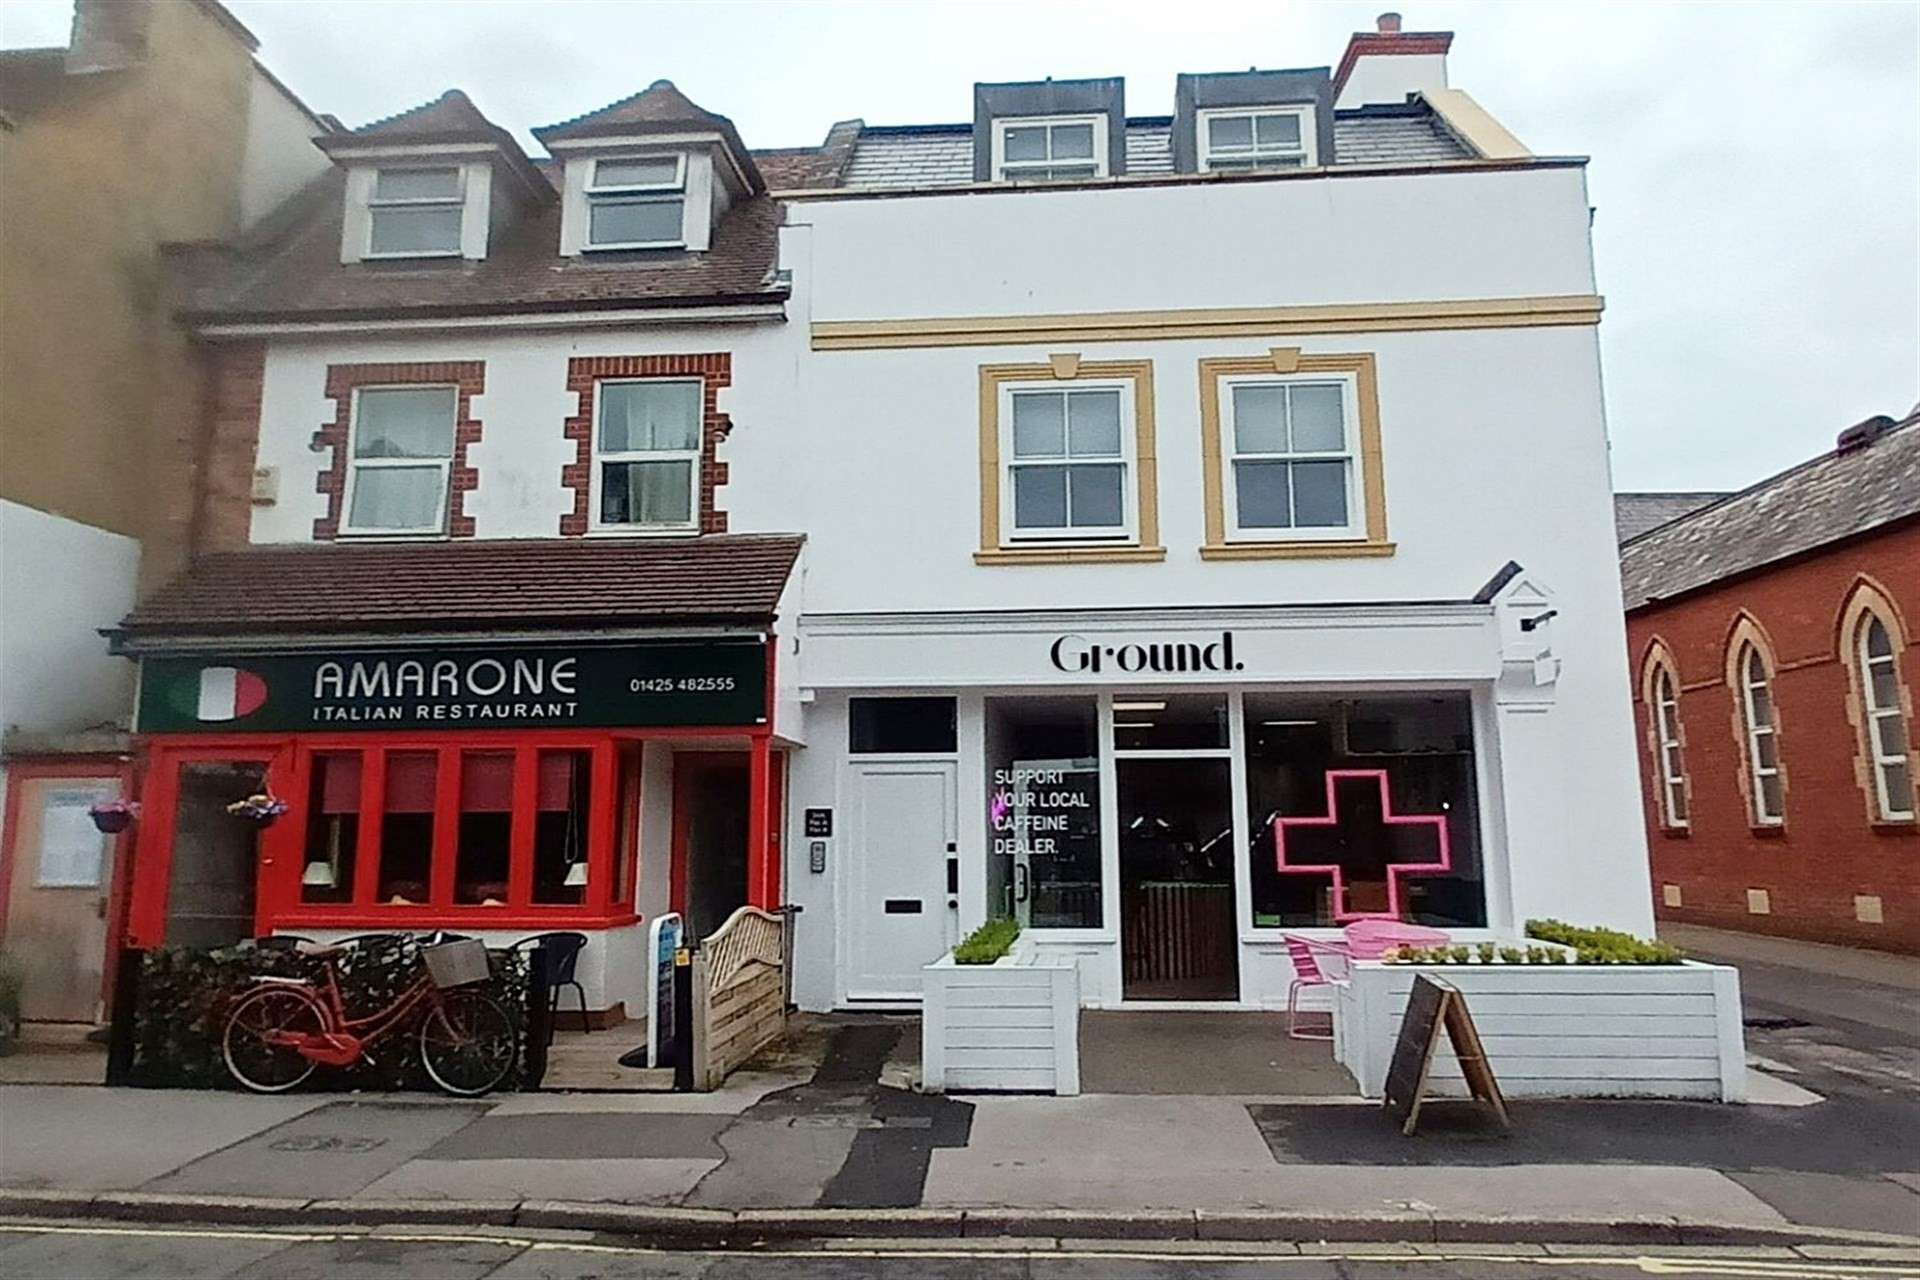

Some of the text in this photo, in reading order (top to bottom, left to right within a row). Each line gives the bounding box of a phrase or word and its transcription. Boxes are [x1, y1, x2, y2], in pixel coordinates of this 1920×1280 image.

[1050, 631, 1244, 673] Ground.
[314, 657, 577, 698] AMARONE
[629, 676, 736, 692] 01425 482555
[312, 702, 578, 721] ITALIAN RESTAURANT
[994, 769, 1065, 785] SUPPORT
[994, 791, 1090, 808] YOUR LOCAL
[994, 814, 1069, 831] CAFFEINE
[994, 837, 1059, 854] DEALER.
